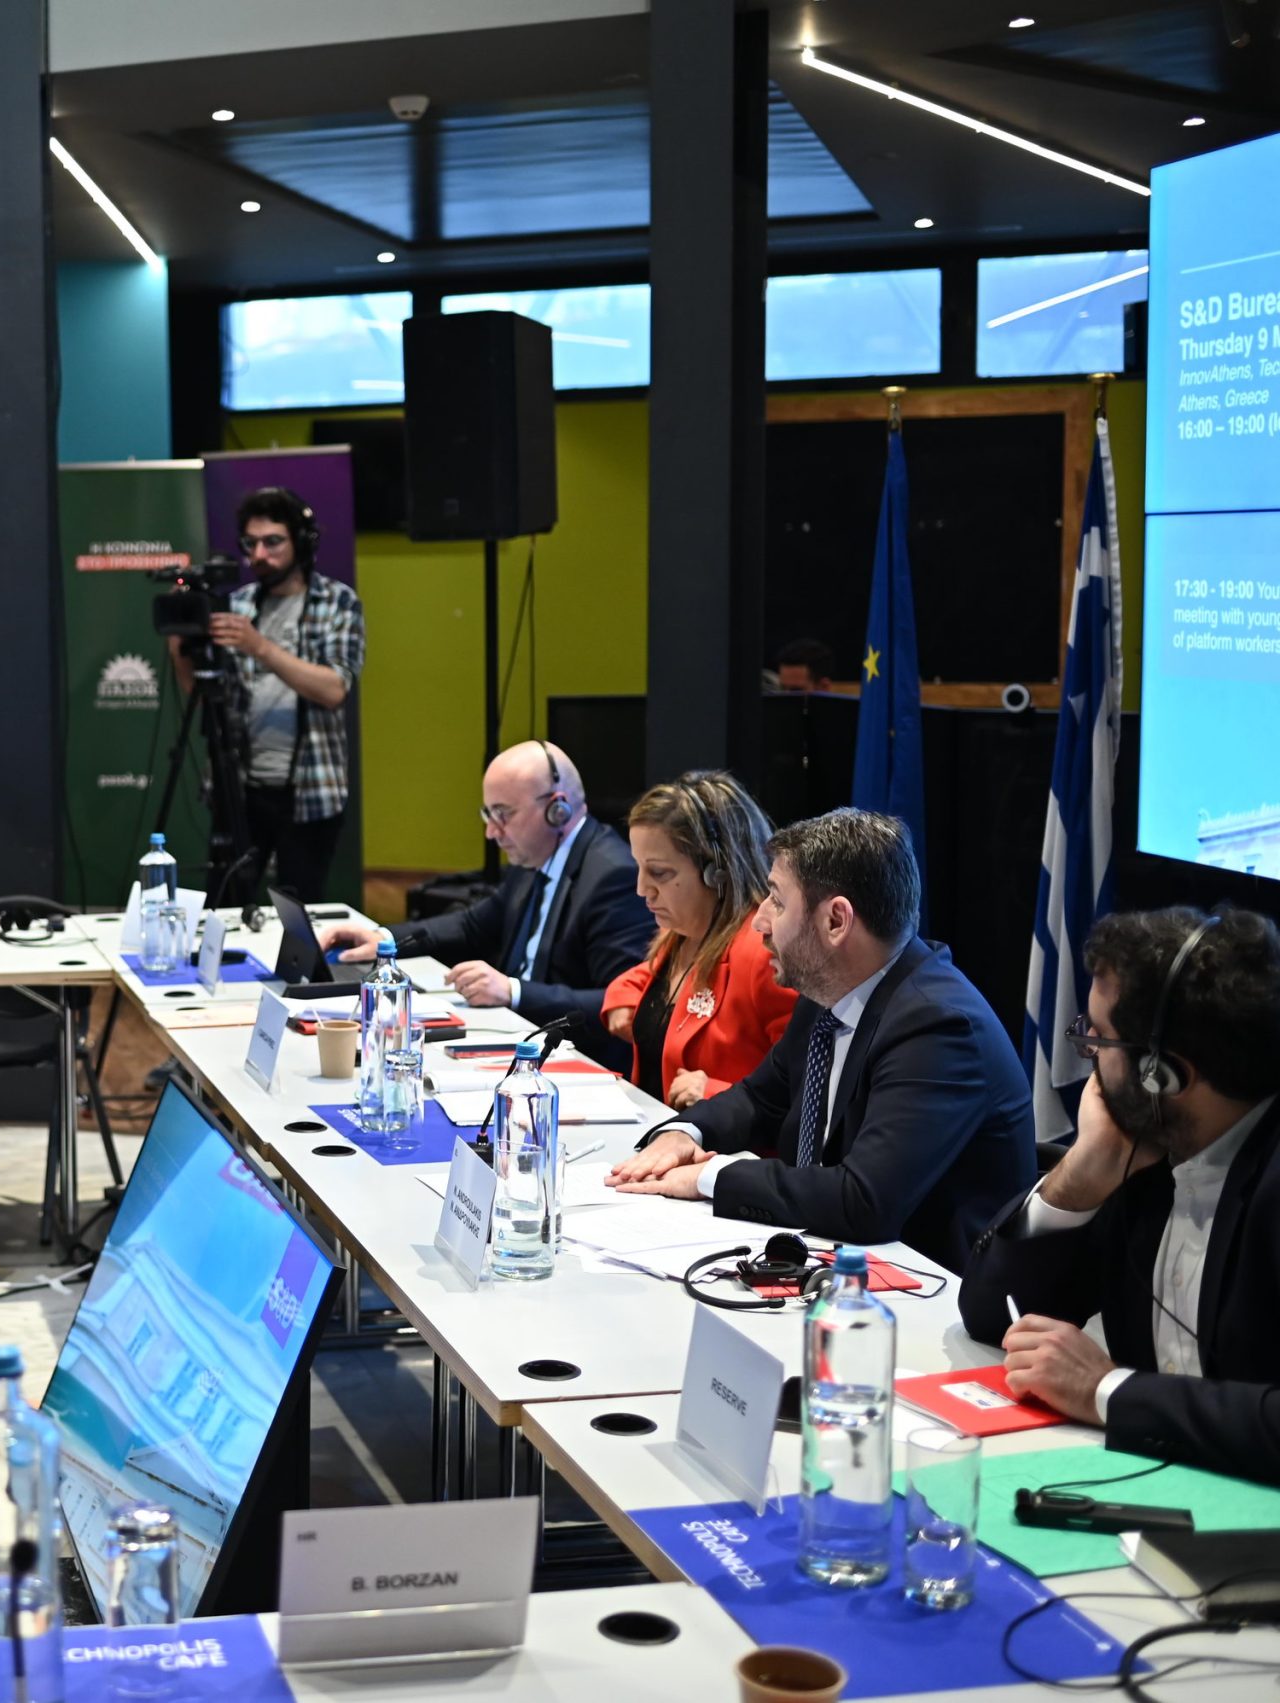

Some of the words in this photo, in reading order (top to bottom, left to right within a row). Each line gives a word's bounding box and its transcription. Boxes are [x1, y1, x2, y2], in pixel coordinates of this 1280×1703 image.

[1179, 295, 1223, 329] S&D
[1179, 332, 1254, 361] Thursday
[1258, 326, 1268, 351] 9
[1179, 363, 1254, 387] InnovAthens,
[1178, 393, 1221, 413] Athens,
[1225, 388, 1270, 408] Greece
[1178, 418, 1213, 440] 16:00
[1228, 413, 1265, 436] 19:00
[1174, 579, 1208, 598] 17:30
[1219, 579, 1254, 599] 19:00
[1174, 606, 1218, 628] meeting
[1221, 607, 1244, 625] with
[1173, 630, 1185, 648] of
[1186, 631, 1233, 653] platform
[1235, 635, 1280, 654] workers
[711, 1377, 748, 1417] RESERVE
[681, 1521, 767, 1590] TECHNOPOLIS
[351, 1576, 368, 1592] B.
[375, 1571, 459, 1591] BORZAN
[63, 1638, 222, 1664] CHNOPOLIS
